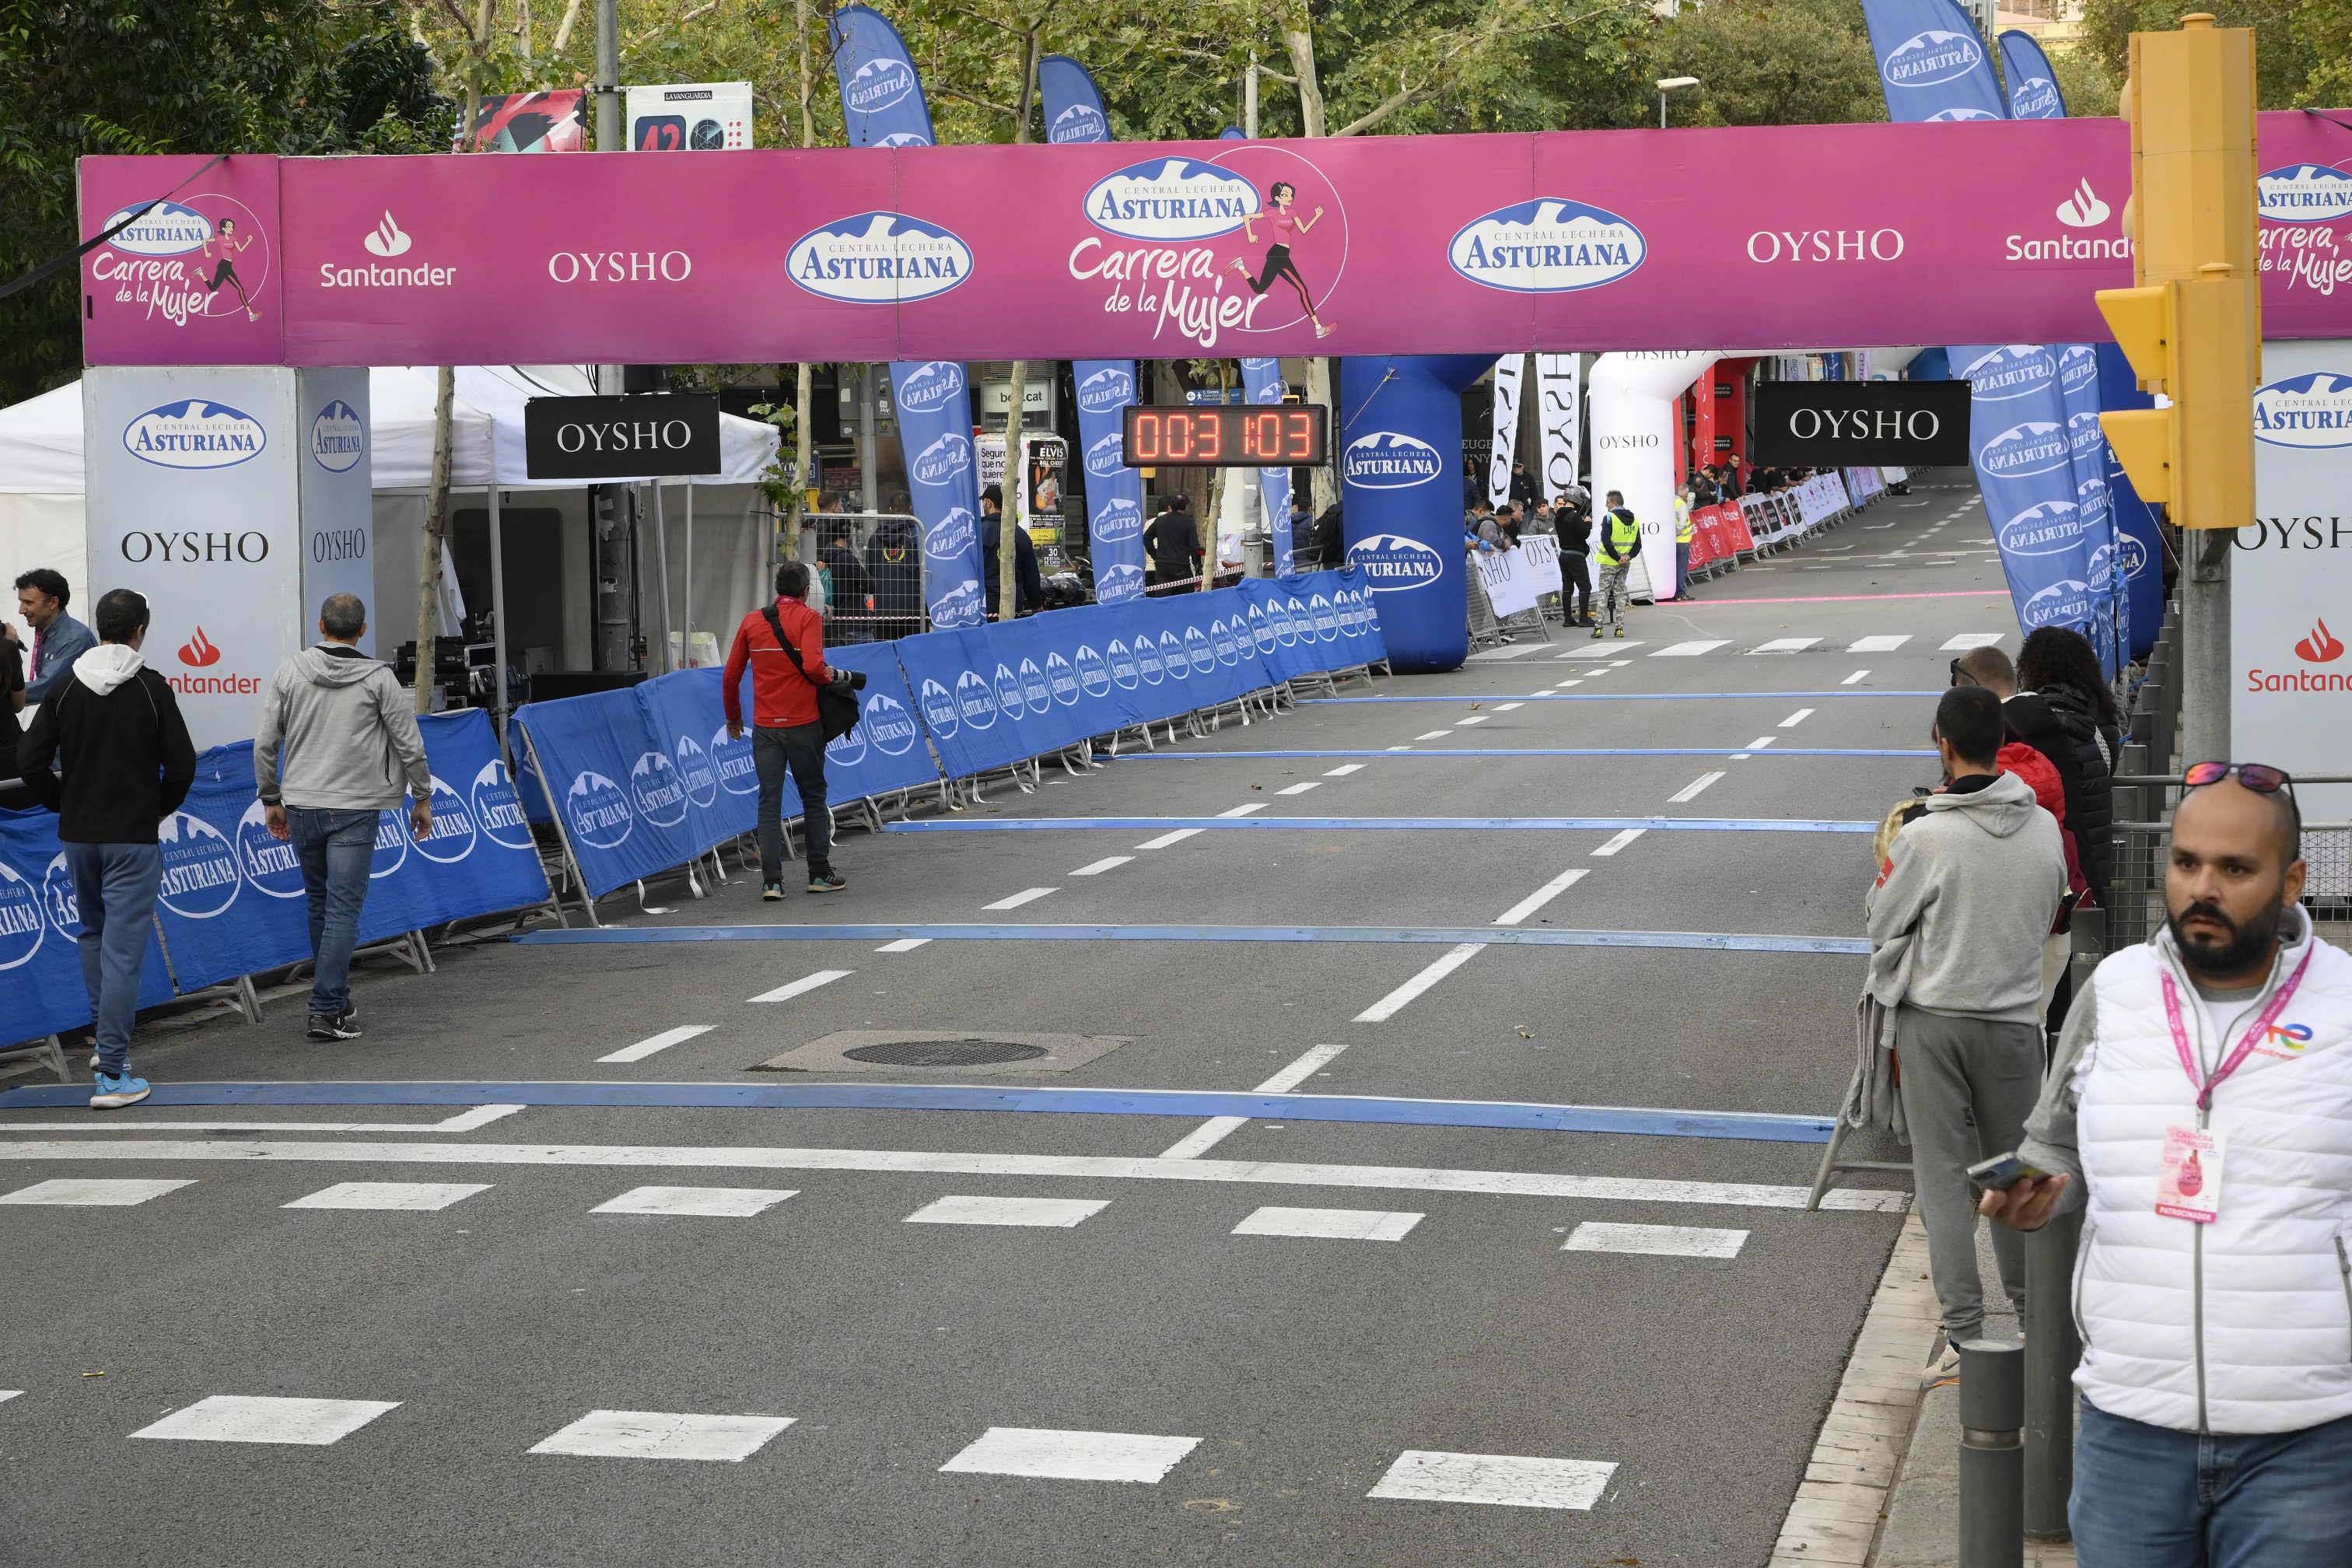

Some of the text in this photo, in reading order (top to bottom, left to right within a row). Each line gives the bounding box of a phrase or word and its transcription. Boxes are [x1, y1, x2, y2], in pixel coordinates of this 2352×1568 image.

[1097, 188, 1246, 220] ASTURIANA
[1124, 185, 1242, 195] CENTRAL LECHERA
[829, 243, 953, 253] CENTRAL LECHERA
[1494, 229, 1625, 241] CENTRAL LECHERA
[1747, 228, 1905, 264] OYSHO
[2005, 235, 2135, 261] Santand
[2259, 226, 2333, 249] arrera
[548, 250, 692, 282] OYSHO
[800, 247, 960, 280] ASTURIANA
[1069, 236, 1214, 280] Carrera
[1463, 235, 1632, 269] ASTURIANA
[93, 251, 184, 282] Carrera
[320, 263, 457, 288] Santander
[2277, 250, 2291, 271] la
[2287, 245, 2352, 296] Muje
[116, 278, 219, 327] de la Mujer
[1104, 274, 1269, 348] de la Mujer
[1790, 408, 1939, 439] OYSHO
[2253, 402, 2352, 430] ASTURI
[134, 425, 257, 452] ASTURIANA
[315, 425, 361, 454] ASTURIANA
[557, 420, 691, 453] OYSHO
[1461, 439, 1493, 450] EUGE
[1599, 434, 1658, 450] OYSHO
[982, 461, 995, 471] que
[1039, 447, 1064, 458] ELVIS
[1346, 456, 1435, 478] ASTURIANA
[121, 531, 269, 563] OYSHO
[313, 528, 366, 563] OYSHO
[2232, 516, 2352, 551] OYSH
[1048, 548, 1058, 557] 30
[1526, 538, 1552, 567] OYS
[1350, 558, 1436, 577] TURIANA
[1482, 553, 1511, 590] SHO
[169, 673, 261, 694] ntander
[713, 754, 755, 781] ASTURIA
[435, 799, 460, 811] LECHERA
[486, 789, 511, 802] CENTRAL
[409, 811, 473, 843] URIANA
[479, 796, 526, 831] ASTUR
[164, 842, 225, 863] CENTRAL LECHERA
[253, 834, 274, 845] CENT
[245, 838, 301, 877] ASTURI
[160, 856, 237, 898] ASTURIANA
[0, 887, 26, 900] ECHERA
